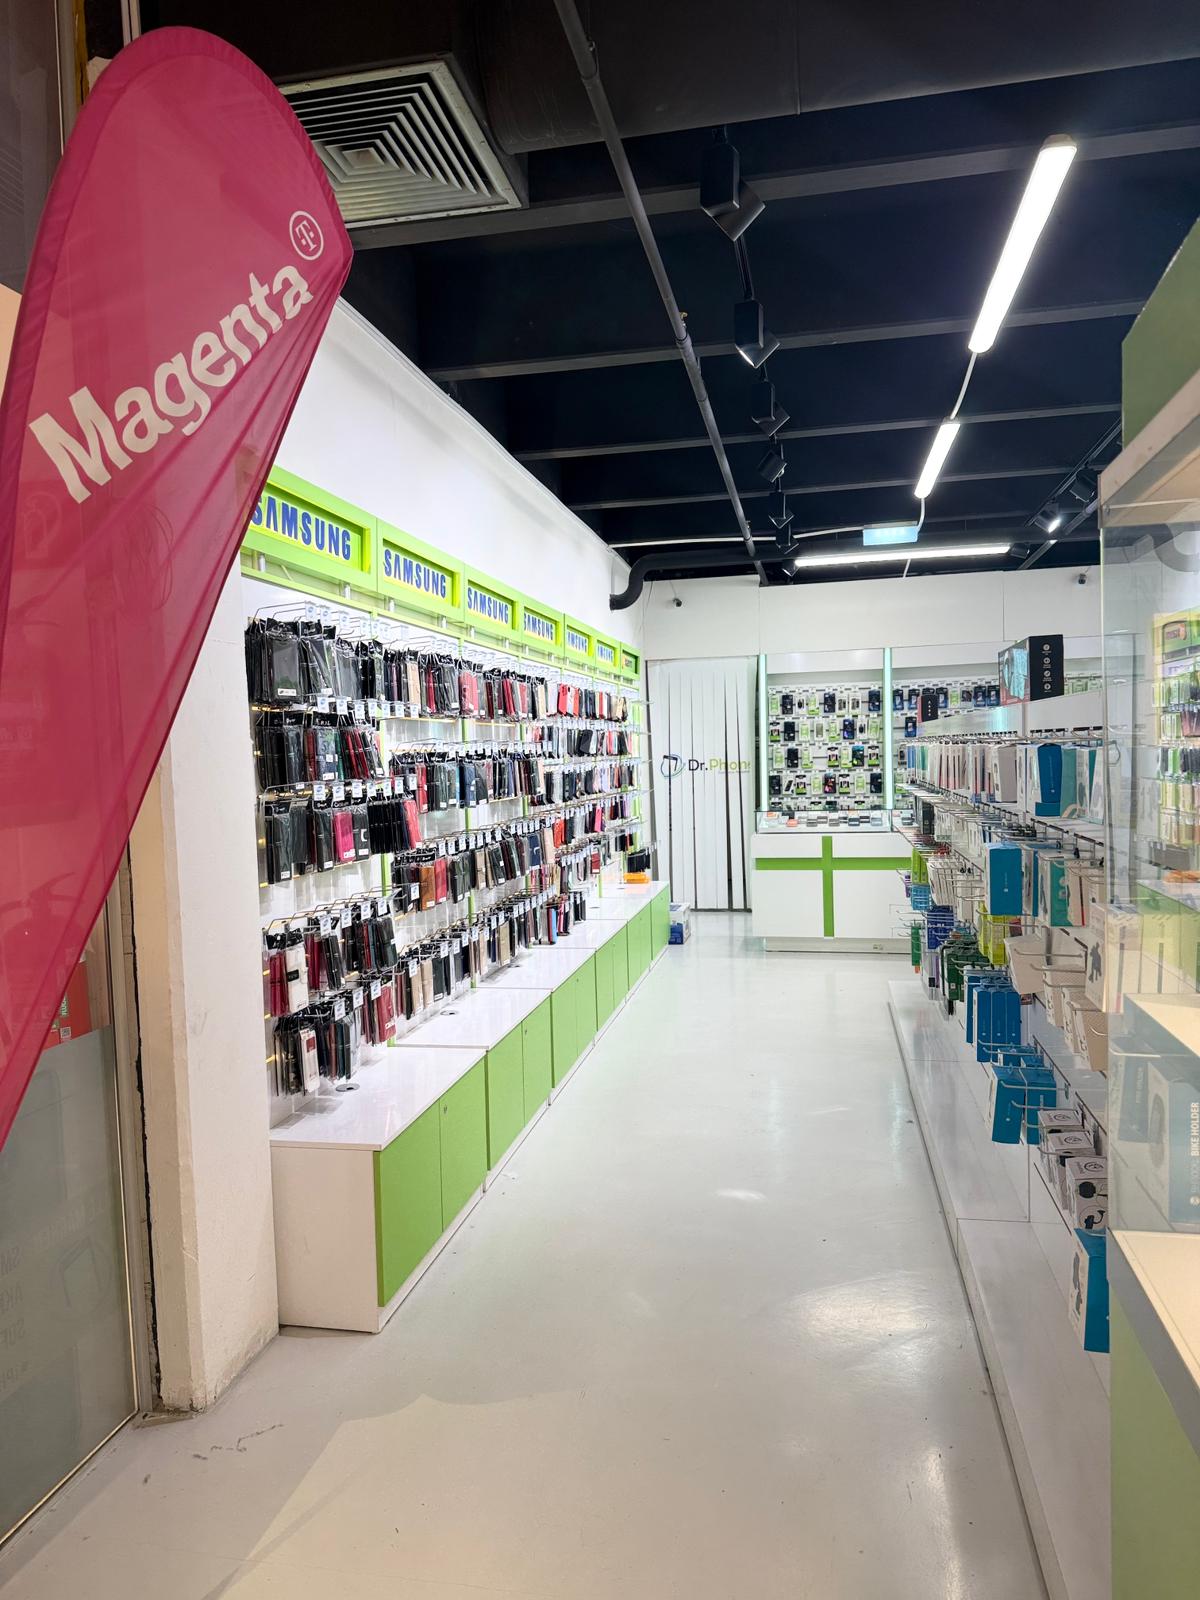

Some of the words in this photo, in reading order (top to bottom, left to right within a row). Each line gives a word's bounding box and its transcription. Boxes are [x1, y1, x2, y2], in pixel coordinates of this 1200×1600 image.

[29, 265, 314, 504] Magenta
[384, 548, 446, 599] SAMSUNG
[467, 587, 509, 625] SAMSUNG
[1190, 1102, 1200, 1136] HOLDER
[1190, 1136, 1200, 1157] BIKE
